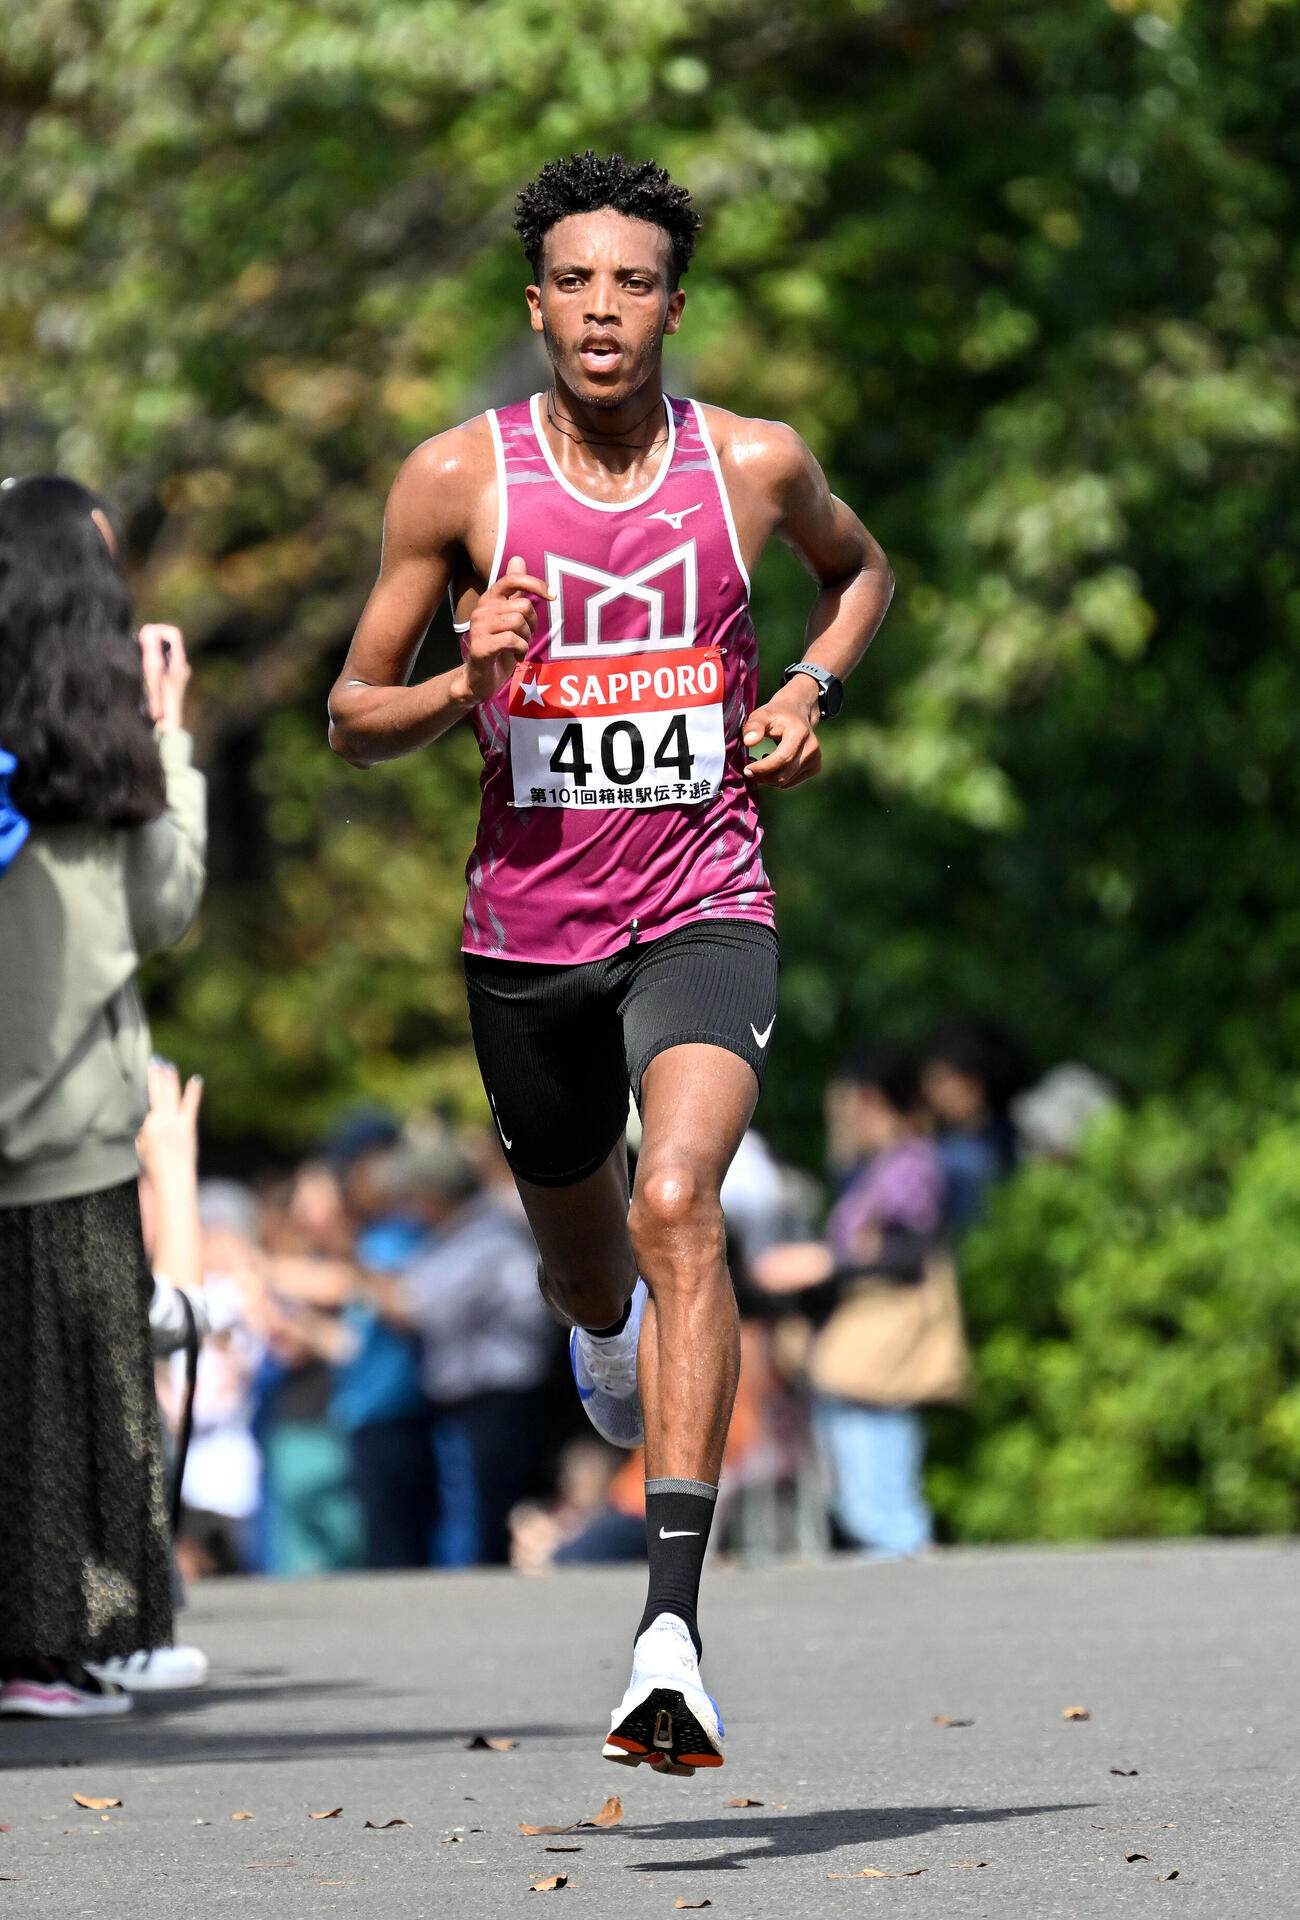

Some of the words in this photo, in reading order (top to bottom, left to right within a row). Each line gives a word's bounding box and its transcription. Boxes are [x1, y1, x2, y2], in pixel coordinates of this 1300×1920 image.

[560, 661, 718, 707] SAPPORO
[550, 713, 695, 787] 404
[530, 779, 711, 805] 第101回箱根駅伝予選会
